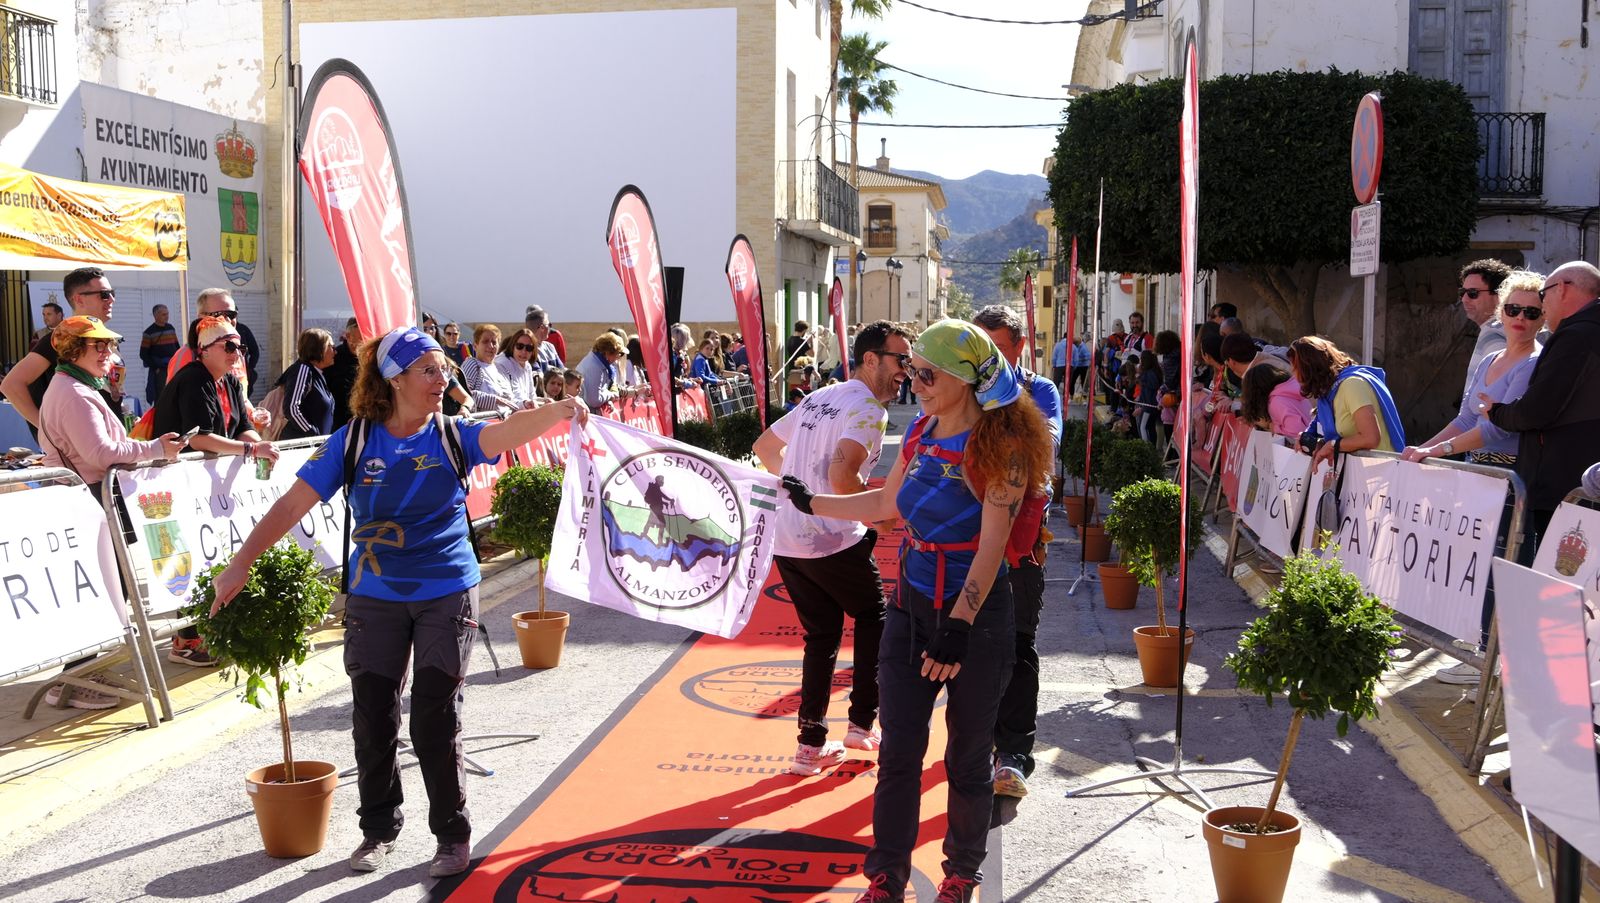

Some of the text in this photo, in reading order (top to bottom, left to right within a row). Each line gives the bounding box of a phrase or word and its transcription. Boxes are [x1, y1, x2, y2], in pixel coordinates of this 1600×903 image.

[96, 117, 208, 161] EXCELENTÍSIMO
[100, 157, 208, 194] AYUNTAMIENTO
[614, 456, 738, 524] CLUB SENDEROS
[570, 466, 595, 571] ALMERÍA
[1457, 514, 1483, 540] DE
[46, 527, 79, 553] DE
[1338, 515, 1478, 596] CANTORIA
[2, 559, 99, 620] RIA
[615, 564, 722, 600] ALMANZORA
[687, 753, 794, 764] antoria
[615, 844, 729, 857] Cantoria
